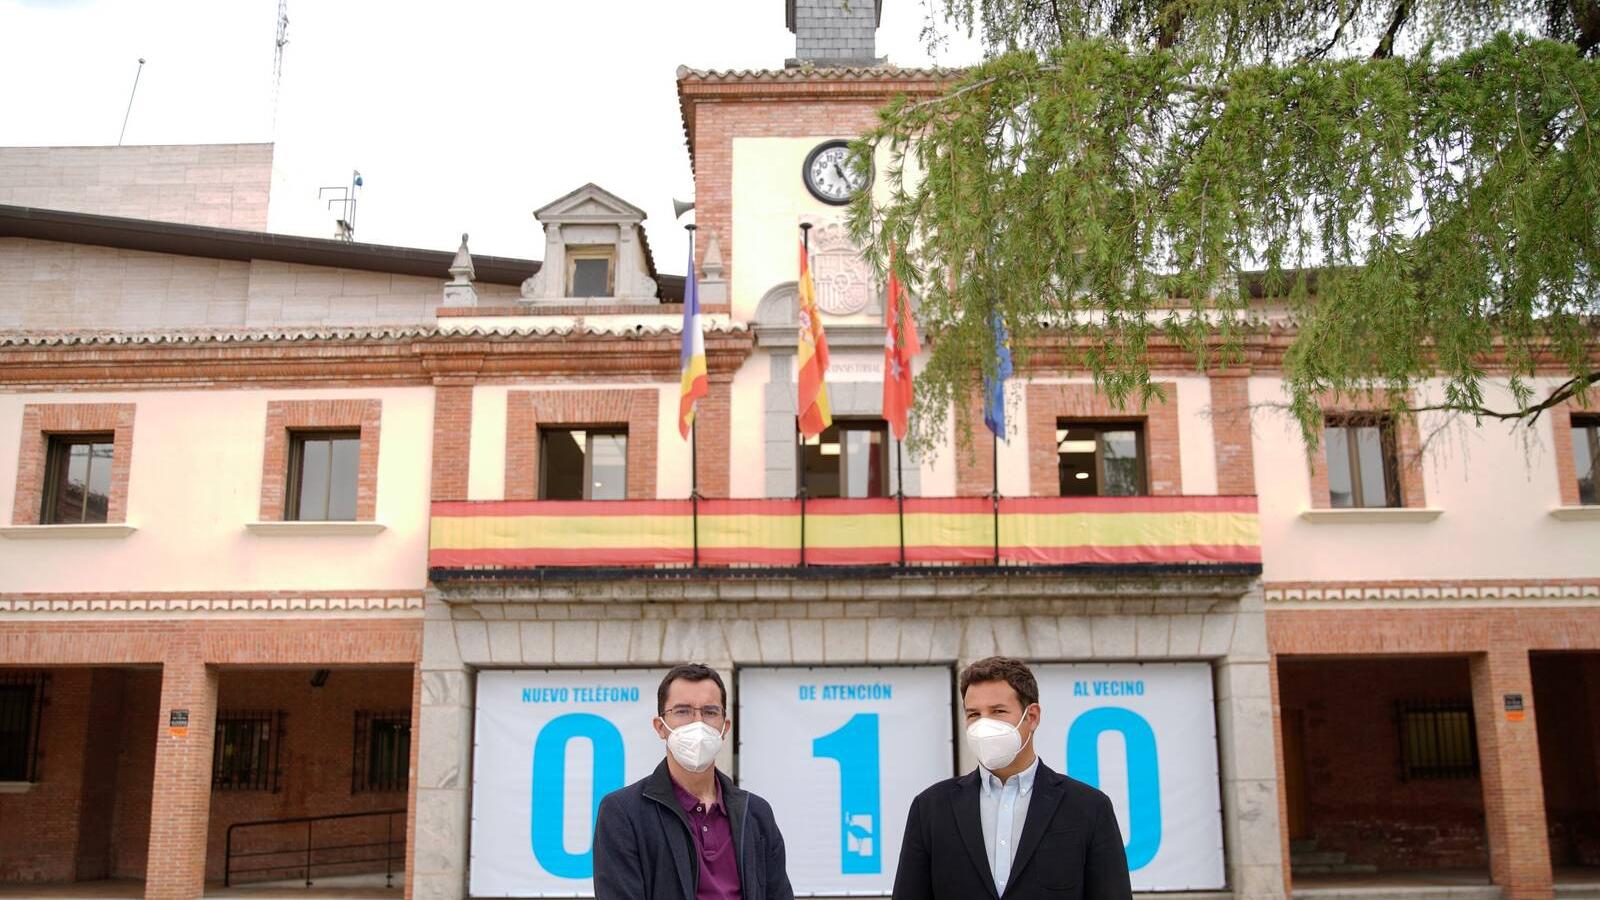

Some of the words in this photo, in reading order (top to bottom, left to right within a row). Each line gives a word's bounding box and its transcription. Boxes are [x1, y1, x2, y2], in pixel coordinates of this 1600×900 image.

[828, 184, 833, 192] 7
[521, 688, 569, 704] NUEVO
[572, 685, 640, 704] TELÉFONO
[799, 686, 816, 701] DE
[821, 683, 893, 702] ATENCIÓN
[1073, 681, 1090, 697] AL
[1092, 680, 1146, 697] VECINO
[531, 711, 626, 880] 0
[811, 711, 883, 876] 1
[1065, 705, 1163, 873] 0
